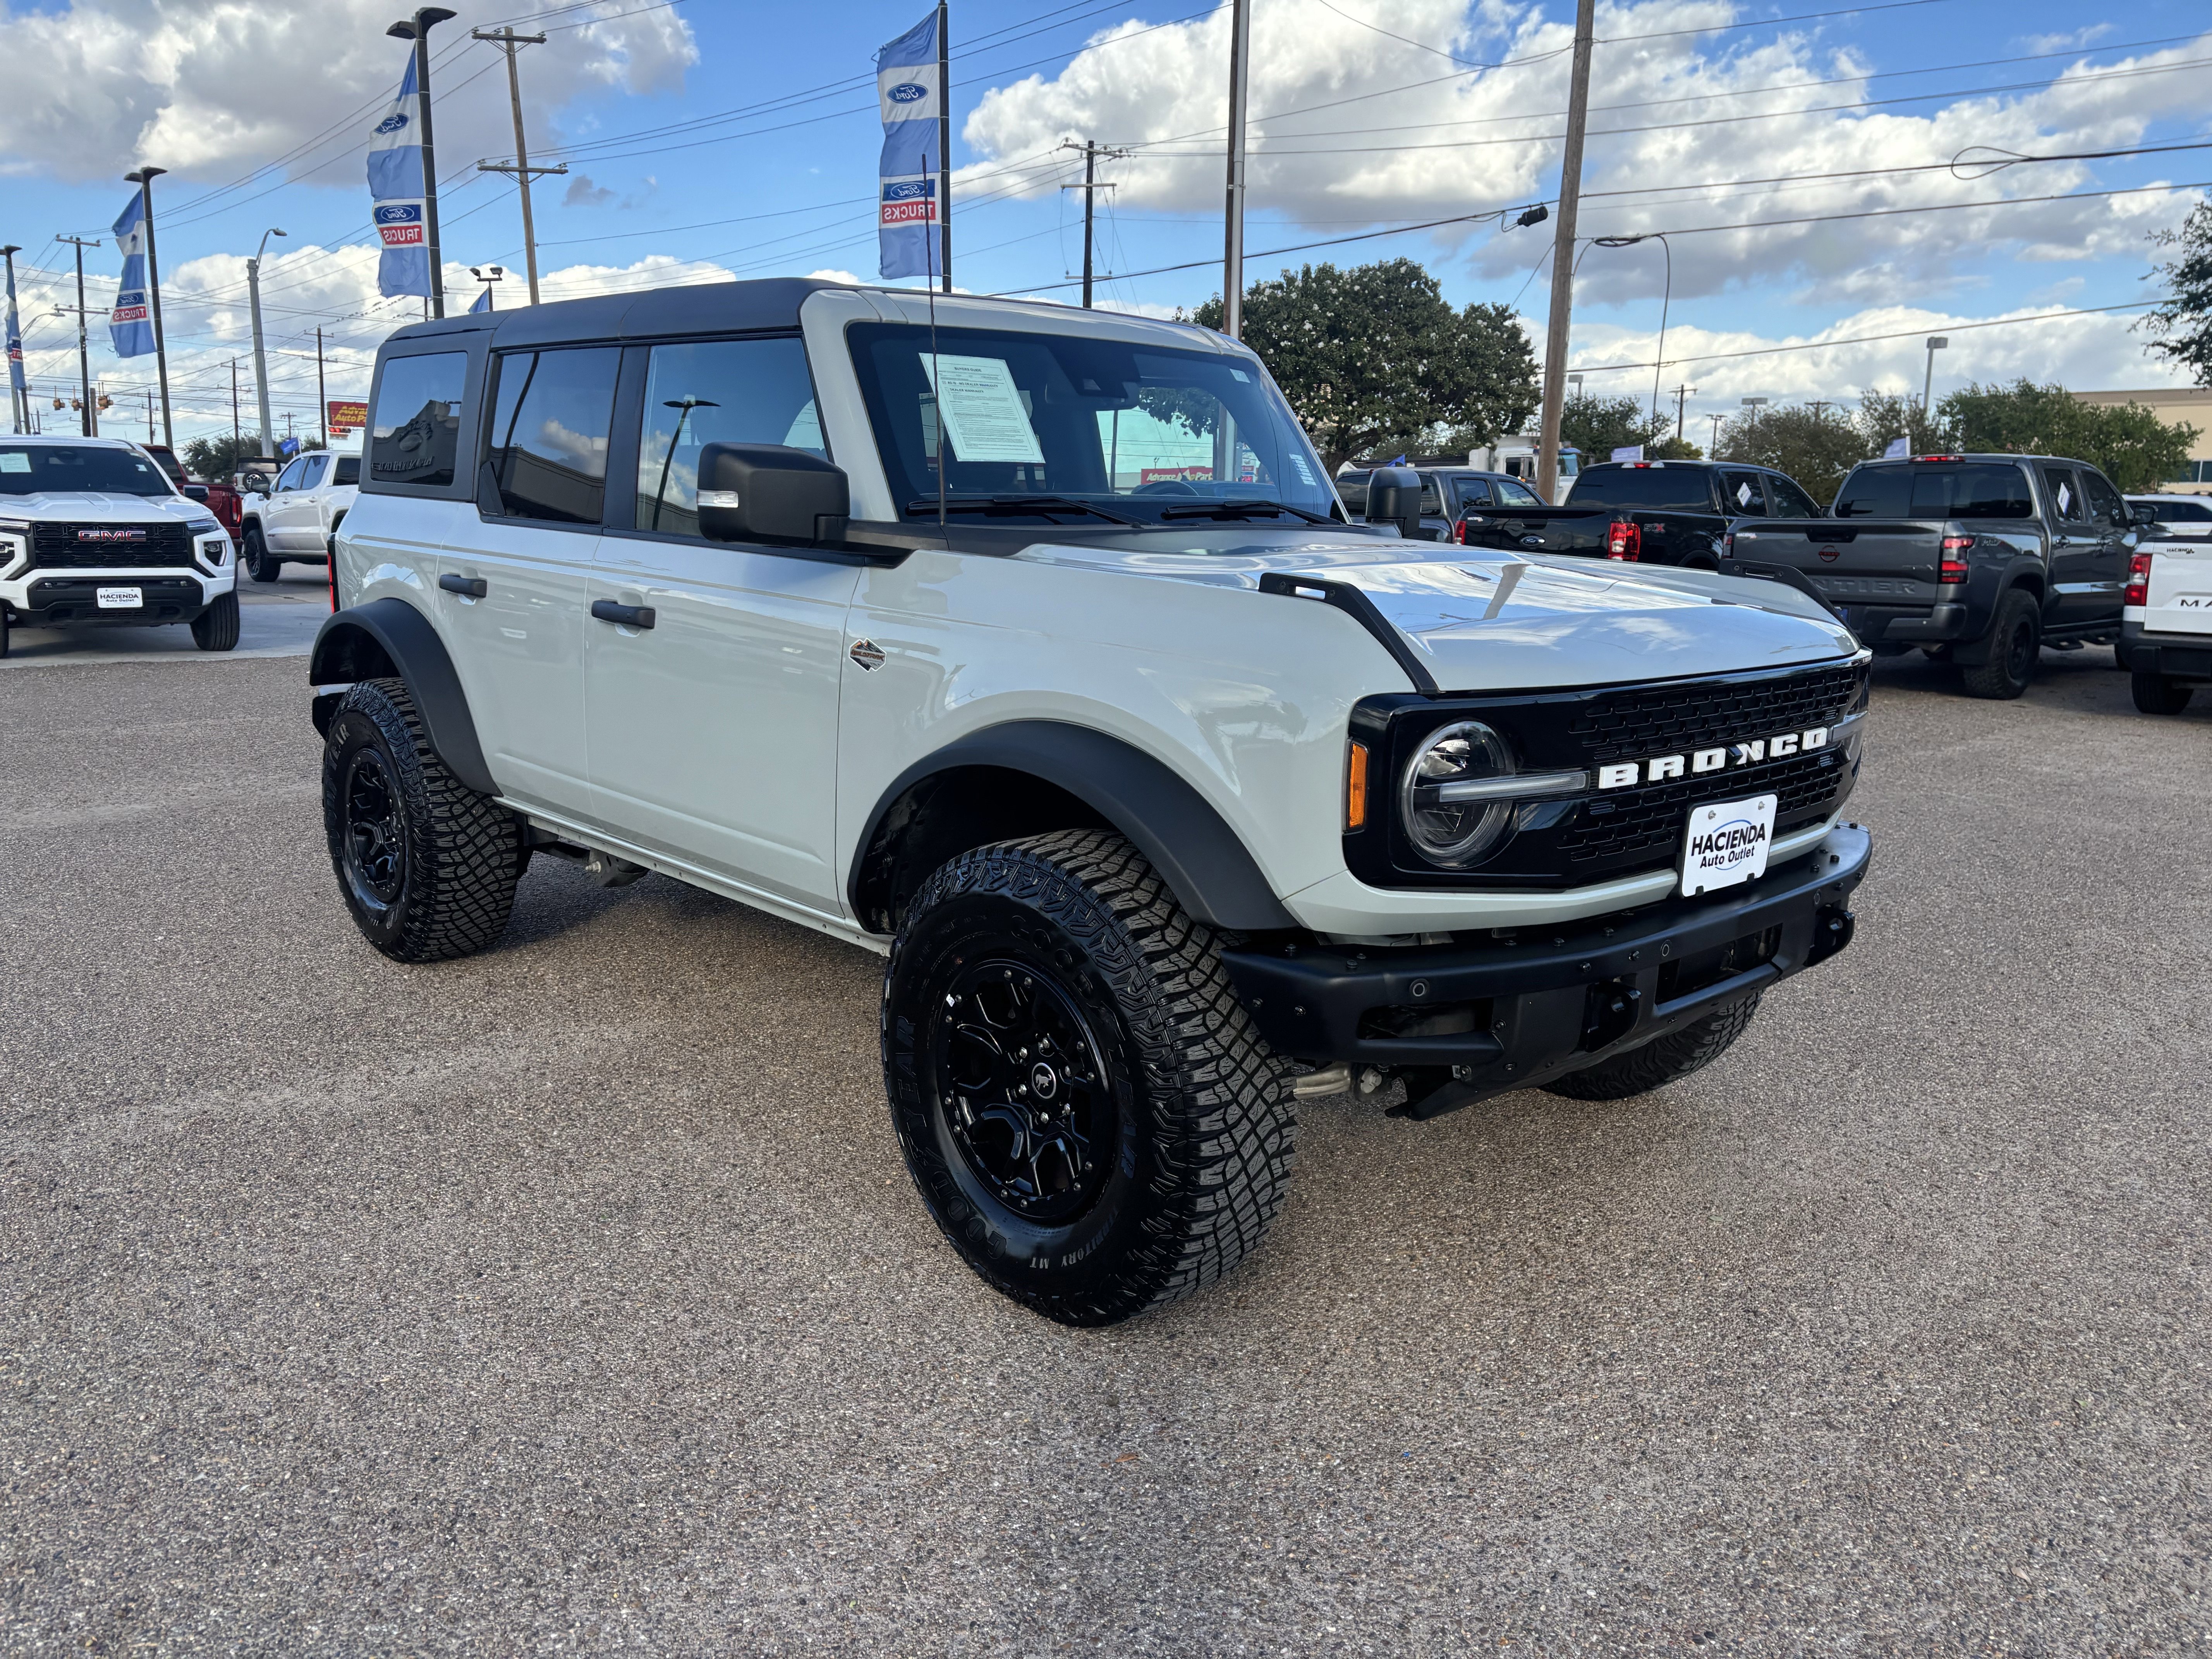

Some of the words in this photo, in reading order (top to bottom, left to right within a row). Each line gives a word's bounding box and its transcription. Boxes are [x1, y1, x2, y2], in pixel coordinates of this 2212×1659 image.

[339, 406, 367, 415] Adva
[334, 414, 357, 422] Auto
[1147, 469, 1177, 481] Advance
[79, 531, 146, 542] GMC
[1812, 578, 1916, 594] NTIER
[1598, 727, 1827, 789] BRONCO
[1691, 823, 1765, 857] HACIENDA
[1700, 854, 1725, 869] Auto
[1728, 845, 1755, 863] Outlet
[1029, 1257, 1049, 1269] MT
